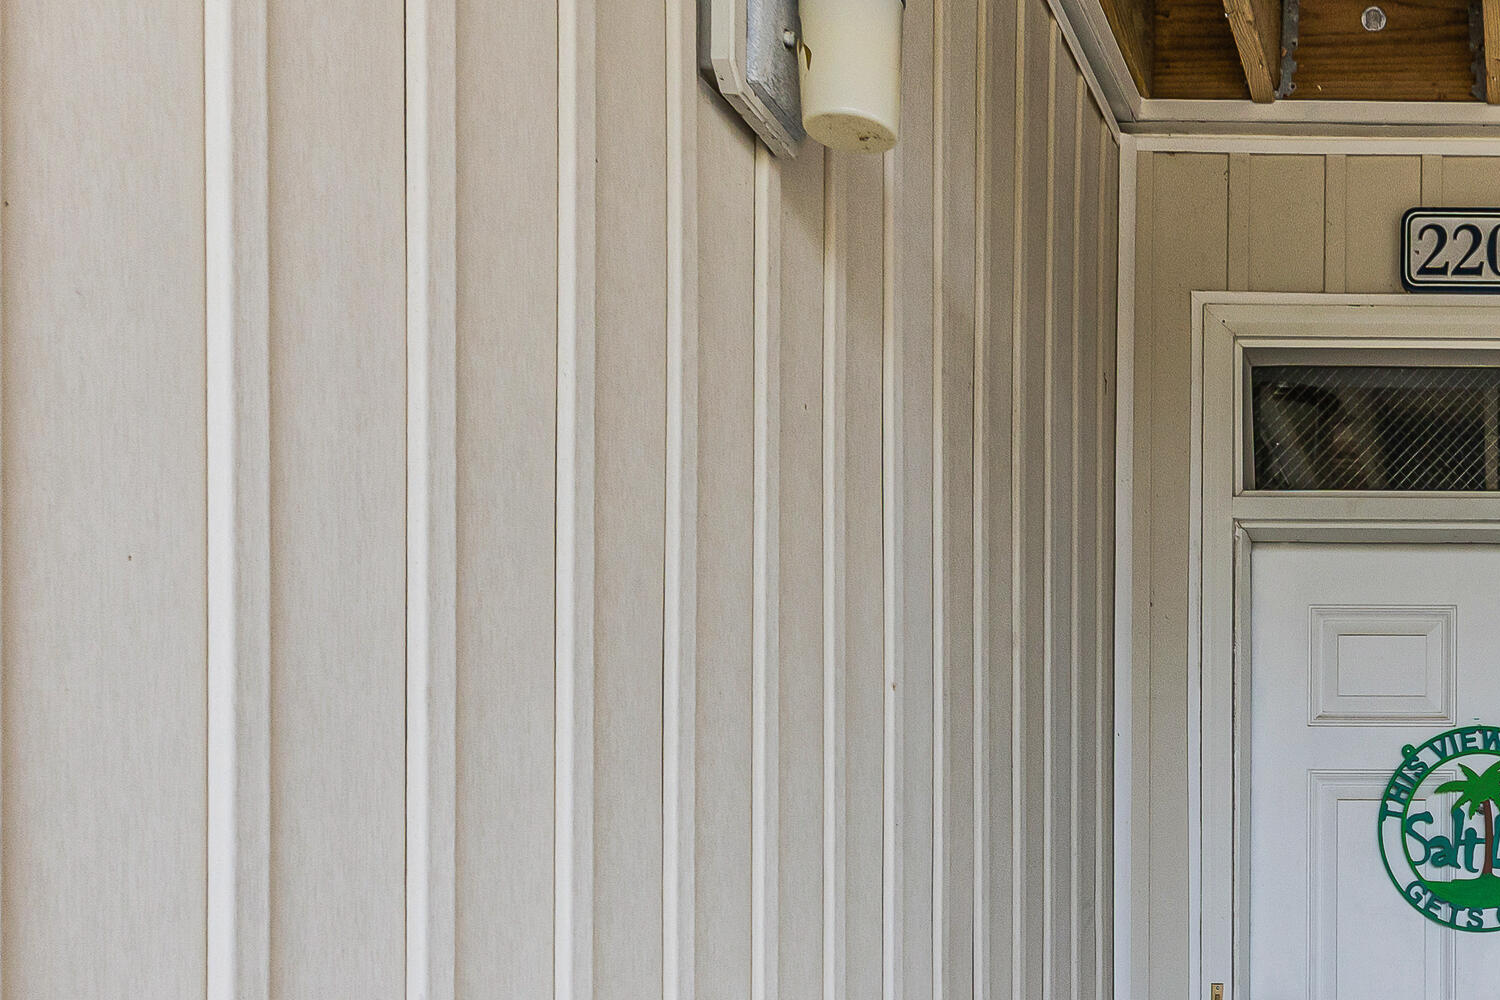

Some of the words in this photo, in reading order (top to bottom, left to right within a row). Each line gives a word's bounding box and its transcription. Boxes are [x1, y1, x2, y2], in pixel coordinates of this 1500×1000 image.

[1380, 755, 1429, 822] THIS
[1405, 807, 1486, 873] Salt
[1405, 881, 1484, 929] GETS
